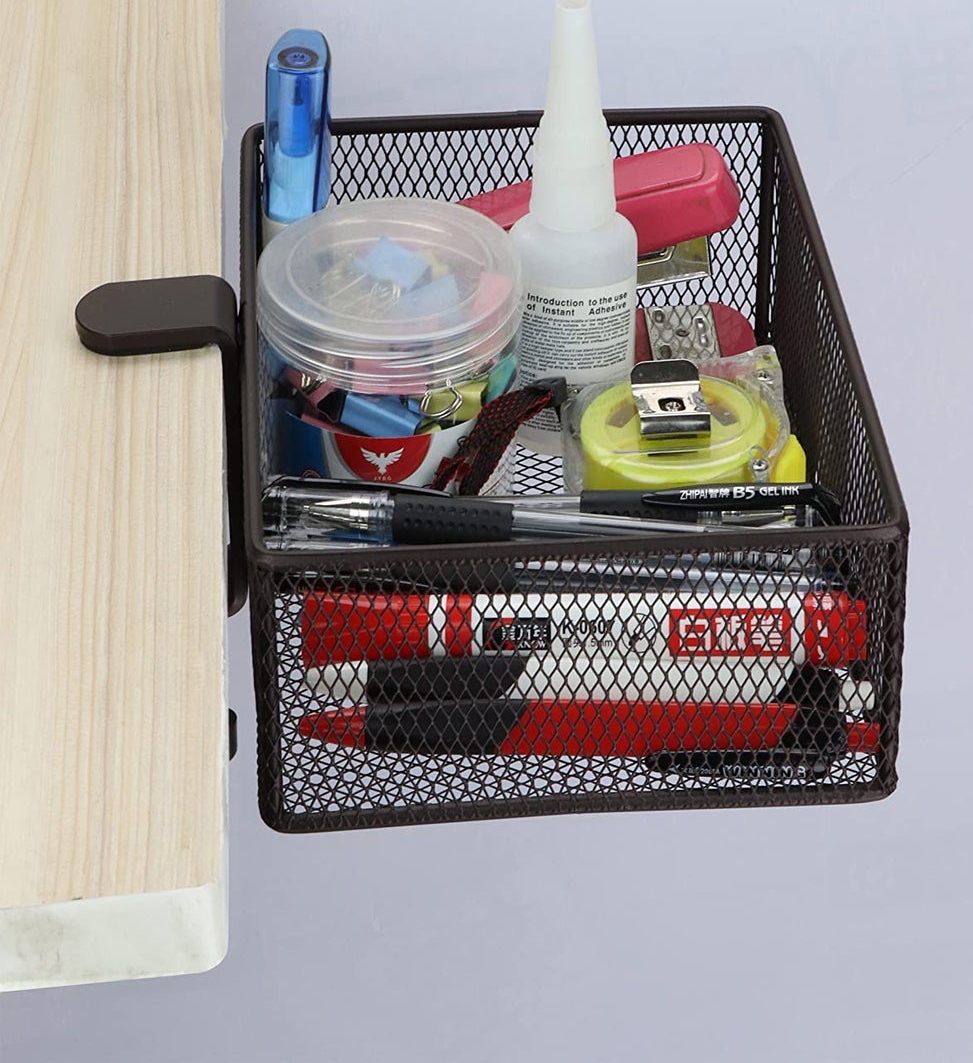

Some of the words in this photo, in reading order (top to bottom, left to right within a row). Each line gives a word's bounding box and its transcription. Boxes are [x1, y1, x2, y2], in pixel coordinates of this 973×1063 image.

[527, 292, 584, 308] Introduction
[588, 297, 599, 306] to
[599, 295, 613, 305] the
[613, 291, 628, 301] use
[526, 303, 537, 312] of
[542, 304, 575, 317] Instant
[588, 301, 628, 317] Adhesive
[732, 486, 755, 500] B5
[759, 486, 780, 497] GEL
[781, 485, 800, 496] INK
[679, 614, 783, 652] 白板笔
